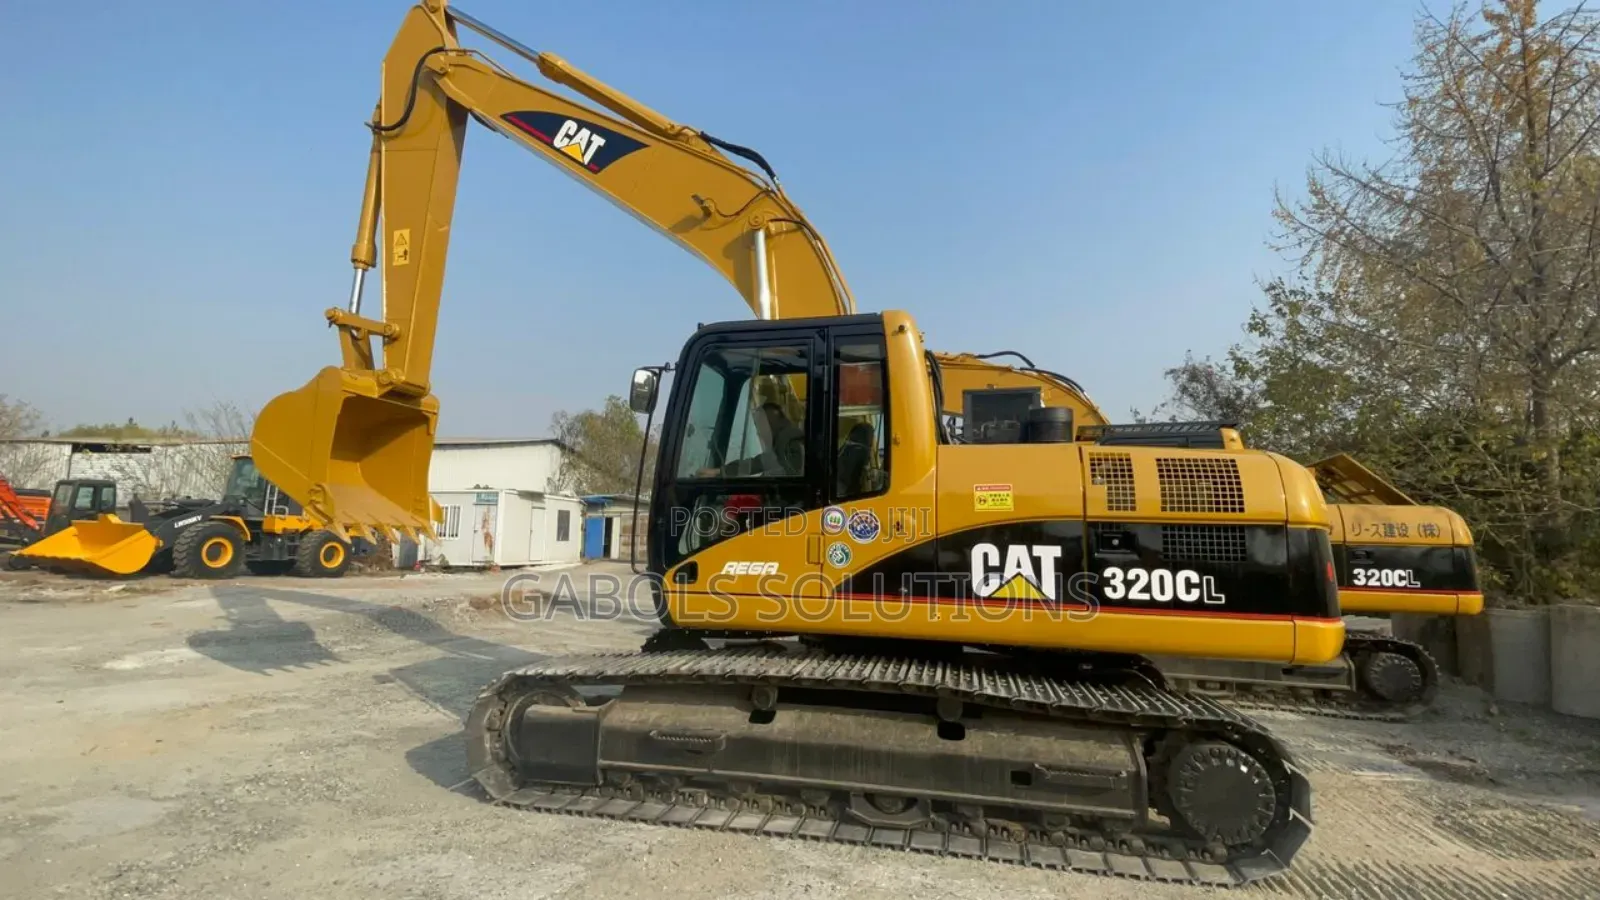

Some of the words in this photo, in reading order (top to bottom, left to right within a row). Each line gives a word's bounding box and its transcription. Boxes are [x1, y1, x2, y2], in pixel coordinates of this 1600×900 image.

[553, 119, 606, 166] CAT
[971, 543, 1061, 600] CAT
[1353, 568, 1421, 588] 320CL
